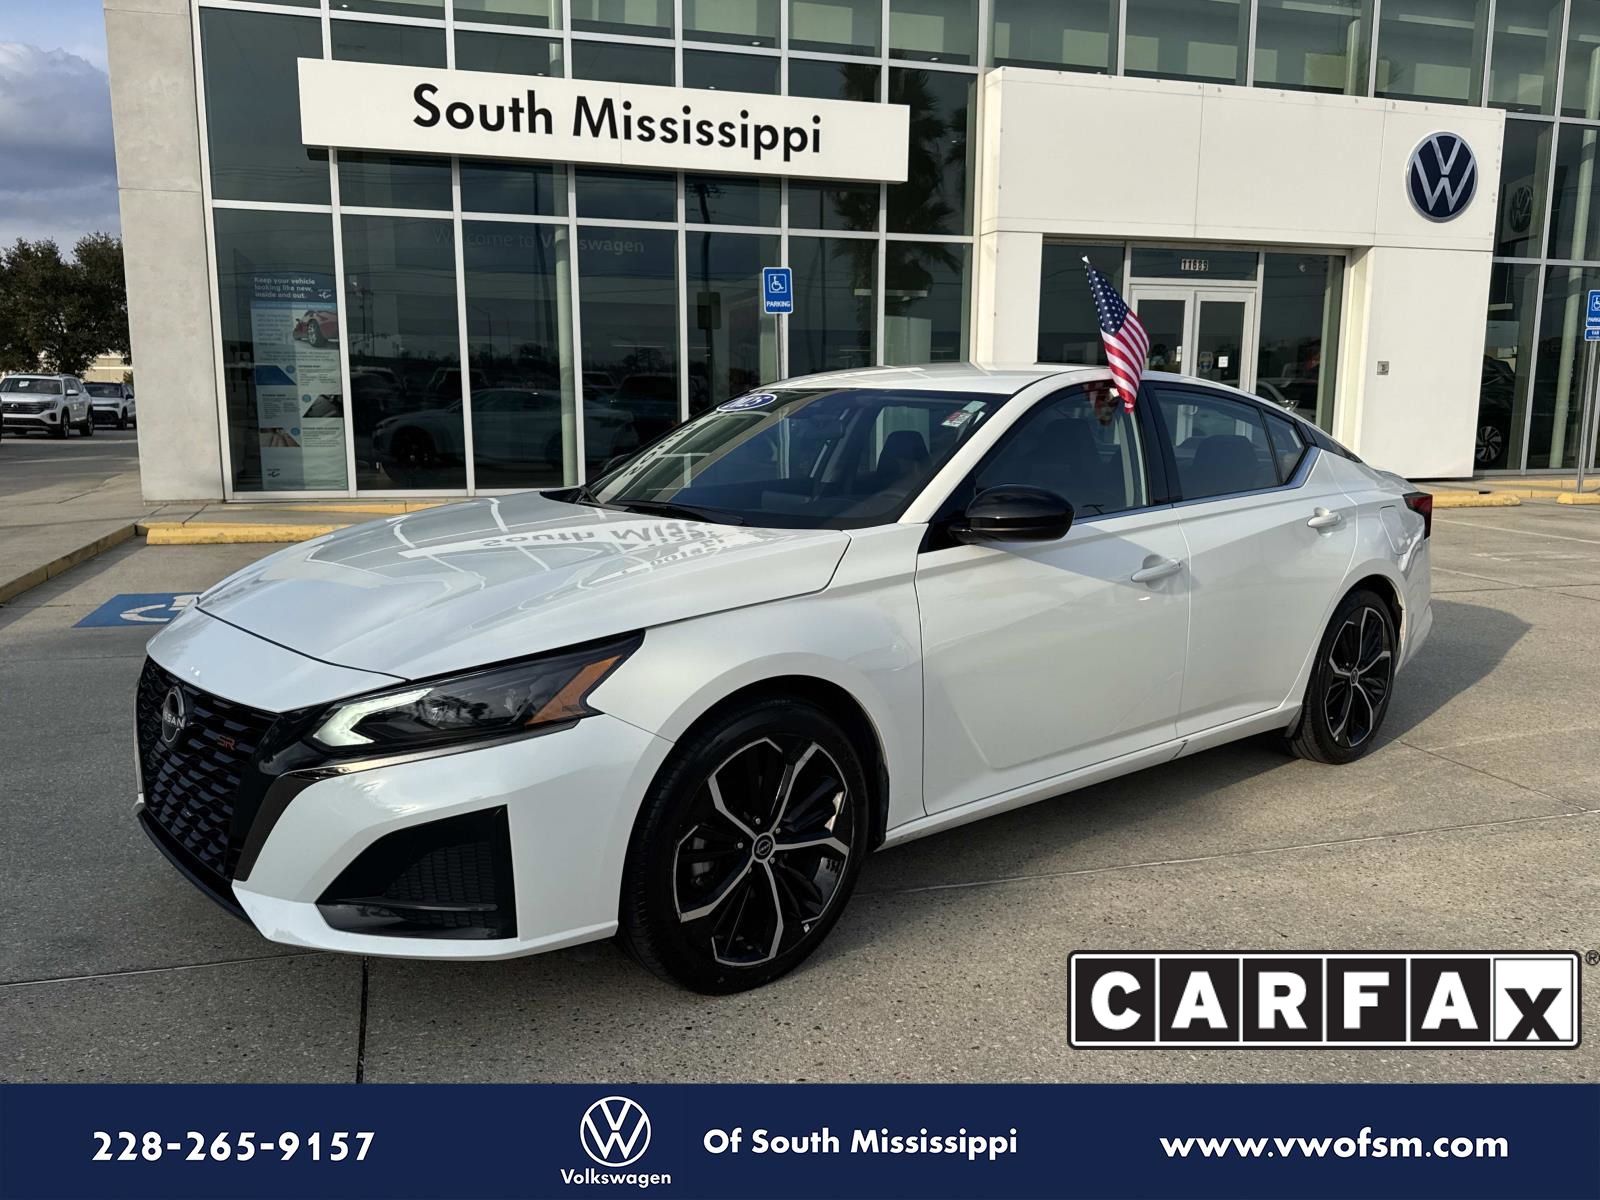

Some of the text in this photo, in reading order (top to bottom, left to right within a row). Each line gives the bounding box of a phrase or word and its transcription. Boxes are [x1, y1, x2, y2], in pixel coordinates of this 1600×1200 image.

[413, 83, 821, 162] South Mississippi
[432, 224, 645, 255] Wcome to Vswagen
[254, 277, 272, 285] Keep
[291, 277, 316, 285] vehicle
[254, 284, 281, 292] looking
[766, 300, 791, 308] PARKING
